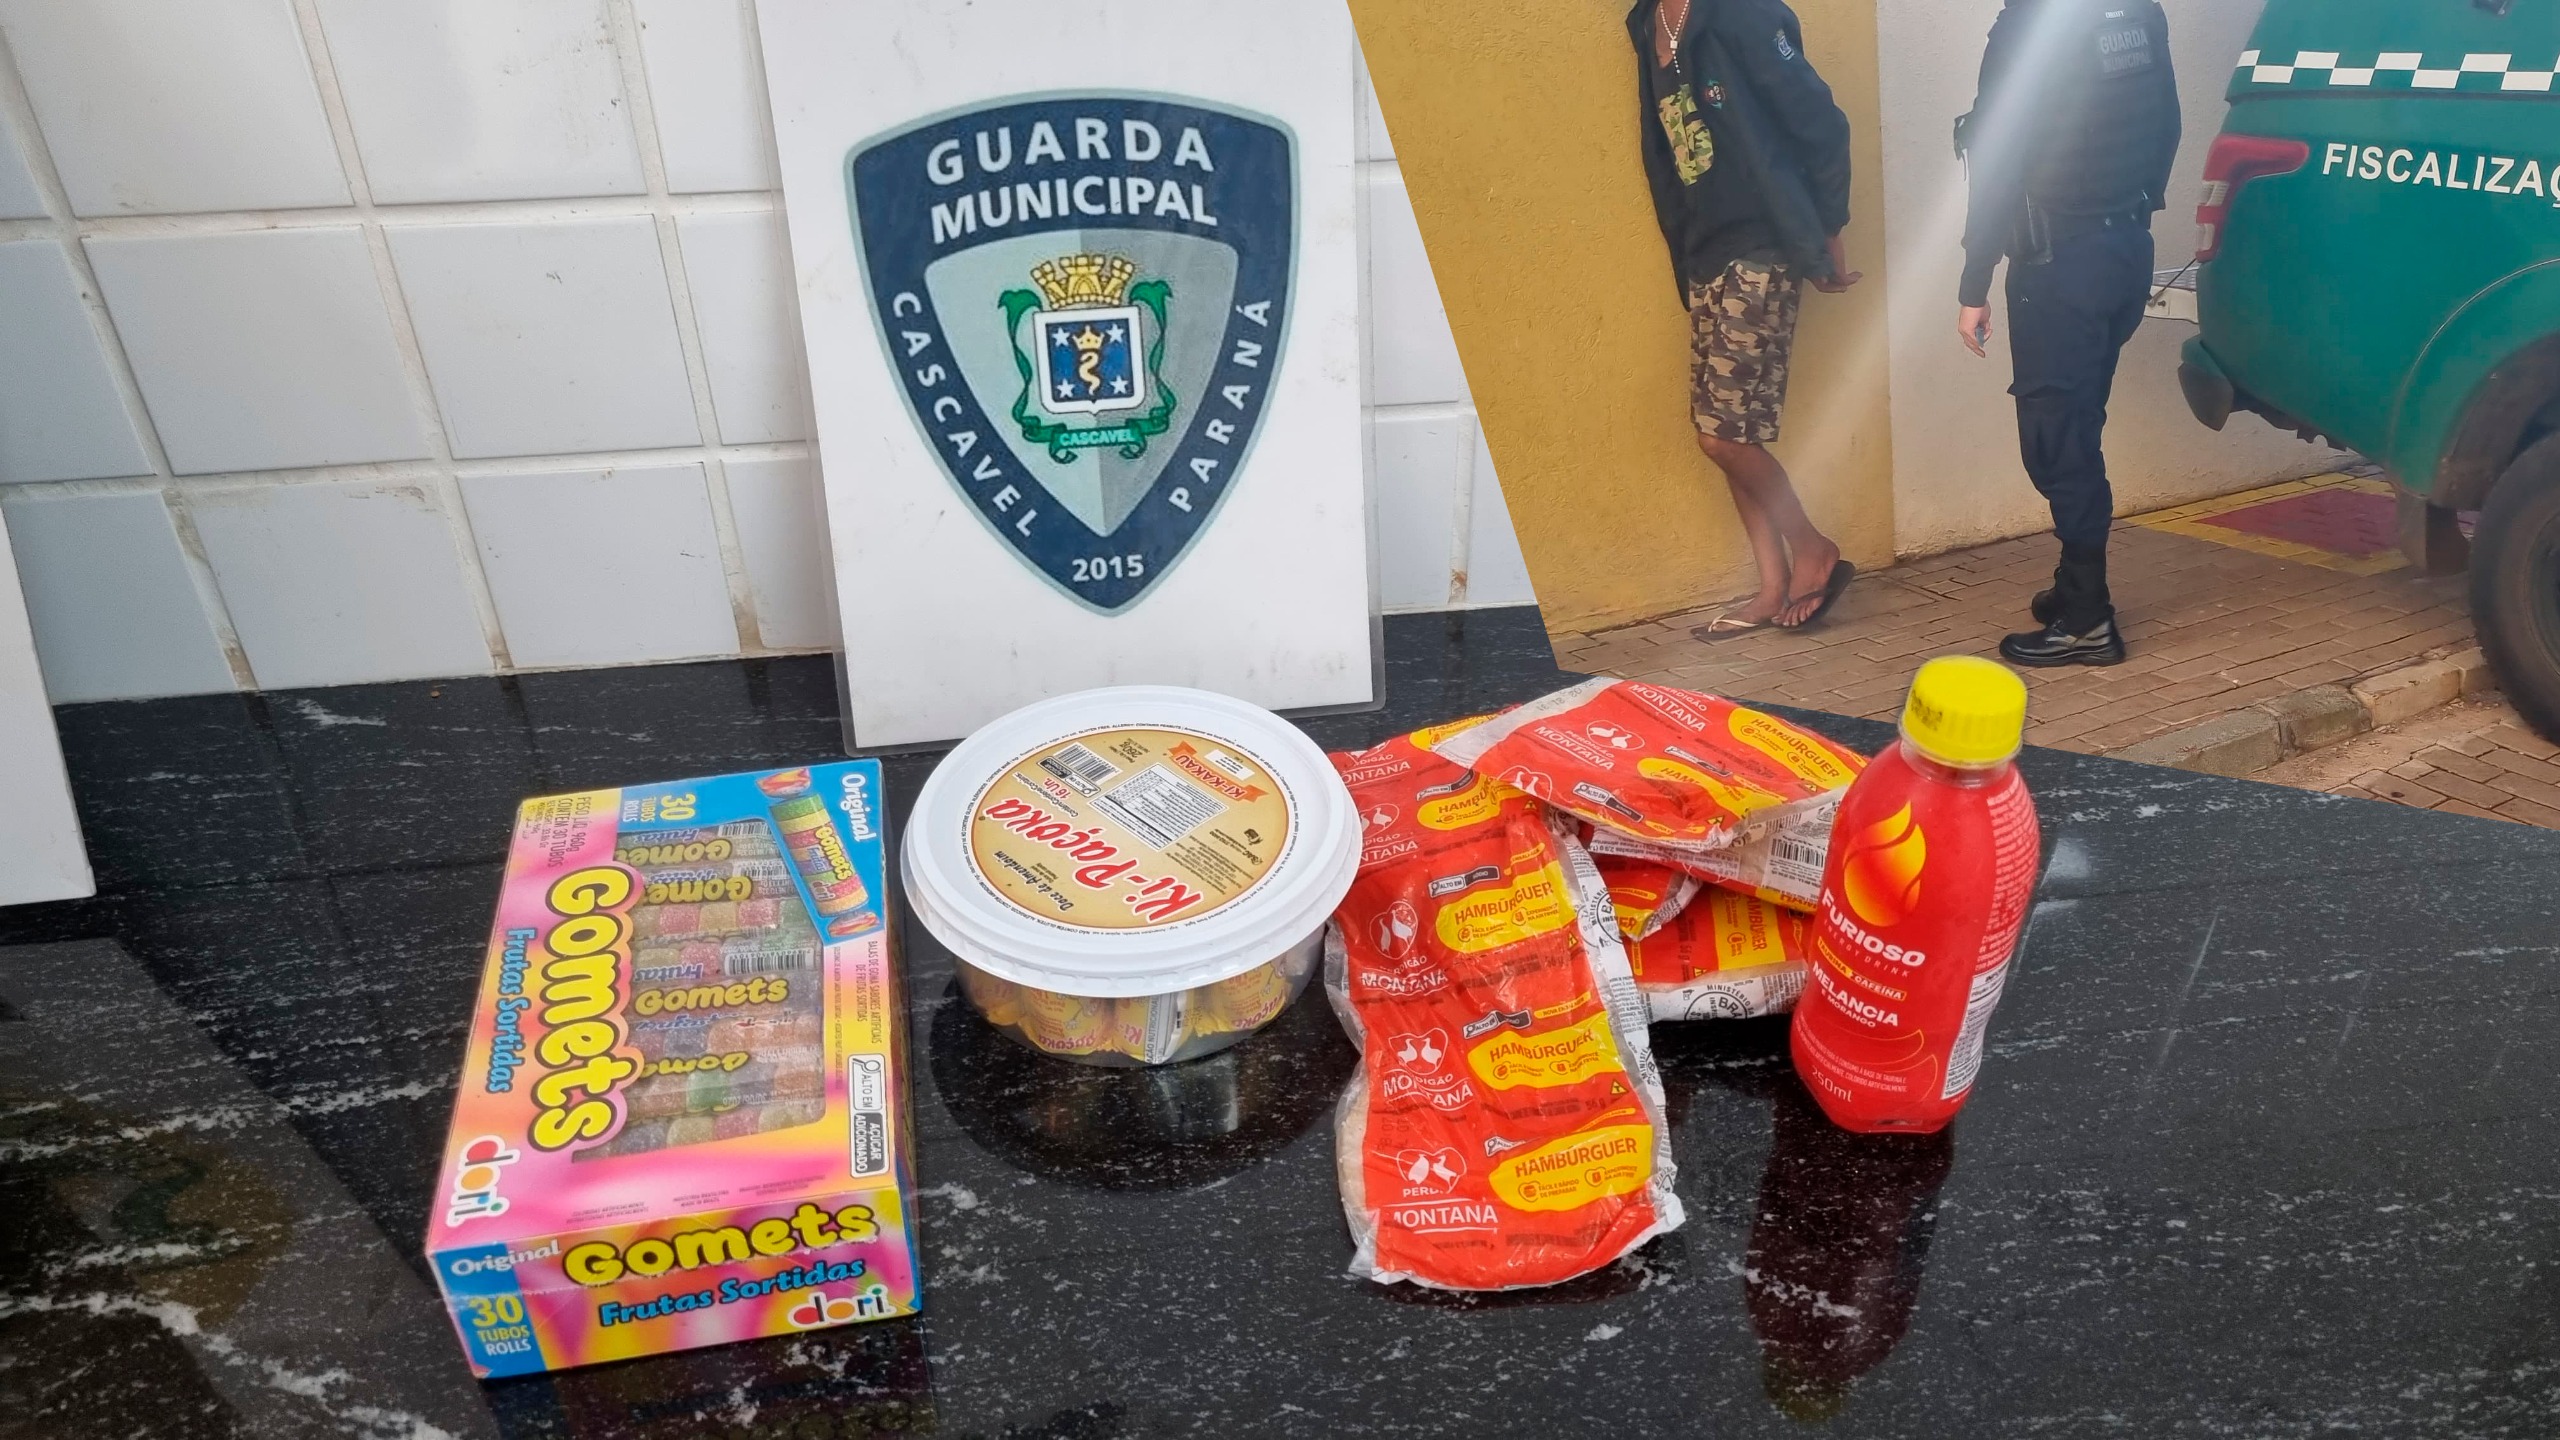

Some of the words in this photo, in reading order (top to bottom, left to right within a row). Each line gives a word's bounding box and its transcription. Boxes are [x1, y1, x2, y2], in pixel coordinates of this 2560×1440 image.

[926, 117, 1214, 186] GUARDA
[931, 176, 1218, 244] MUNICIPAL
[892, 292, 1033, 538] CASCAVEL
[1169, 299, 1272, 513] PARANÁ
[1059, 429, 1137, 447] CASCAVEL
[1072, 554, 1145, 582] 2015
[1628, 684, 1707, 732] MONTANA
[1357, 754, 1394, 766] DIGÃO
[1534, 726, 1615, 770] MONTANA
[1751, 718, 1840, 778] HAMBÚRGUER
[1056, 787, 1071, 799] 16
[1175, 755, 1246, 799] KI-KAKAU
[623, 799, 640, 823] ROLLS
[659, 793, 697, 821] 30
[840, 773, 877, 842] Original
[815, 824, 854, 881] Gomets
[1363, 833, 1401, 846] DIGÃO
[986, 799, 1201, 922] Ki-Paçoka
[994, 850, 1042, 884] Amendoim
[1038, 883, 1052, 893] de
[1050, 891, 1074, 911] Doce
[1439, 881, 1454, 889] ALTO
[1454, 879, 1463, 887] EM
[1454, 881, 1554, 925] HAMBÚRGUER
[1822, 887, 1926, 967] FURIOSO
[498, 928, 536, 993] Frutas
[634, 962, 704, 982] Frutas
[1864, 956, 1911, 978] DRINK
[634, 977, 789, 1016] Gomets
[1812, 960, 1899, 1027] MELANCIA
[1854, 975, 1902, 1000] CAFEÍNA
[530, 865, 637, 1152] Gomets
[1827, 995, 1876, 1028] MORANGO
[485, 994, 529, 1093] Sortidas
[1490, 1028, 1595, 1063] HAMBÚRGUER
[861, 1073, 873, 1095] ALTO
[1414, 1073, 1454, 1086] DIGÃO
[1811, 1064, 1852, 1103] 250ml
[862, 1095, 873, 1109] EM
[855, 1114, 868, 1172] ADICIONADO
[869, 1122, 884, 1161] AÇÚCAR
[1515, 1137, 1638, 1178] HAMBÚRGUER
[453, 1139, 515, 1219] dori
[451, 1240, 562, 1278] Original
[564, 1202, 881, 1286] Gomets
[470, 1294, 524, 1328] 30
[600, 1290, 713, 1327] Frutas
[718, 1258, 866, 1305] Sortidas
[792, 1286, 887, 1325] dori
[477, 1325, 530, 1343] TUBOS
[485, 1338, 532, 1357] ROLLS
